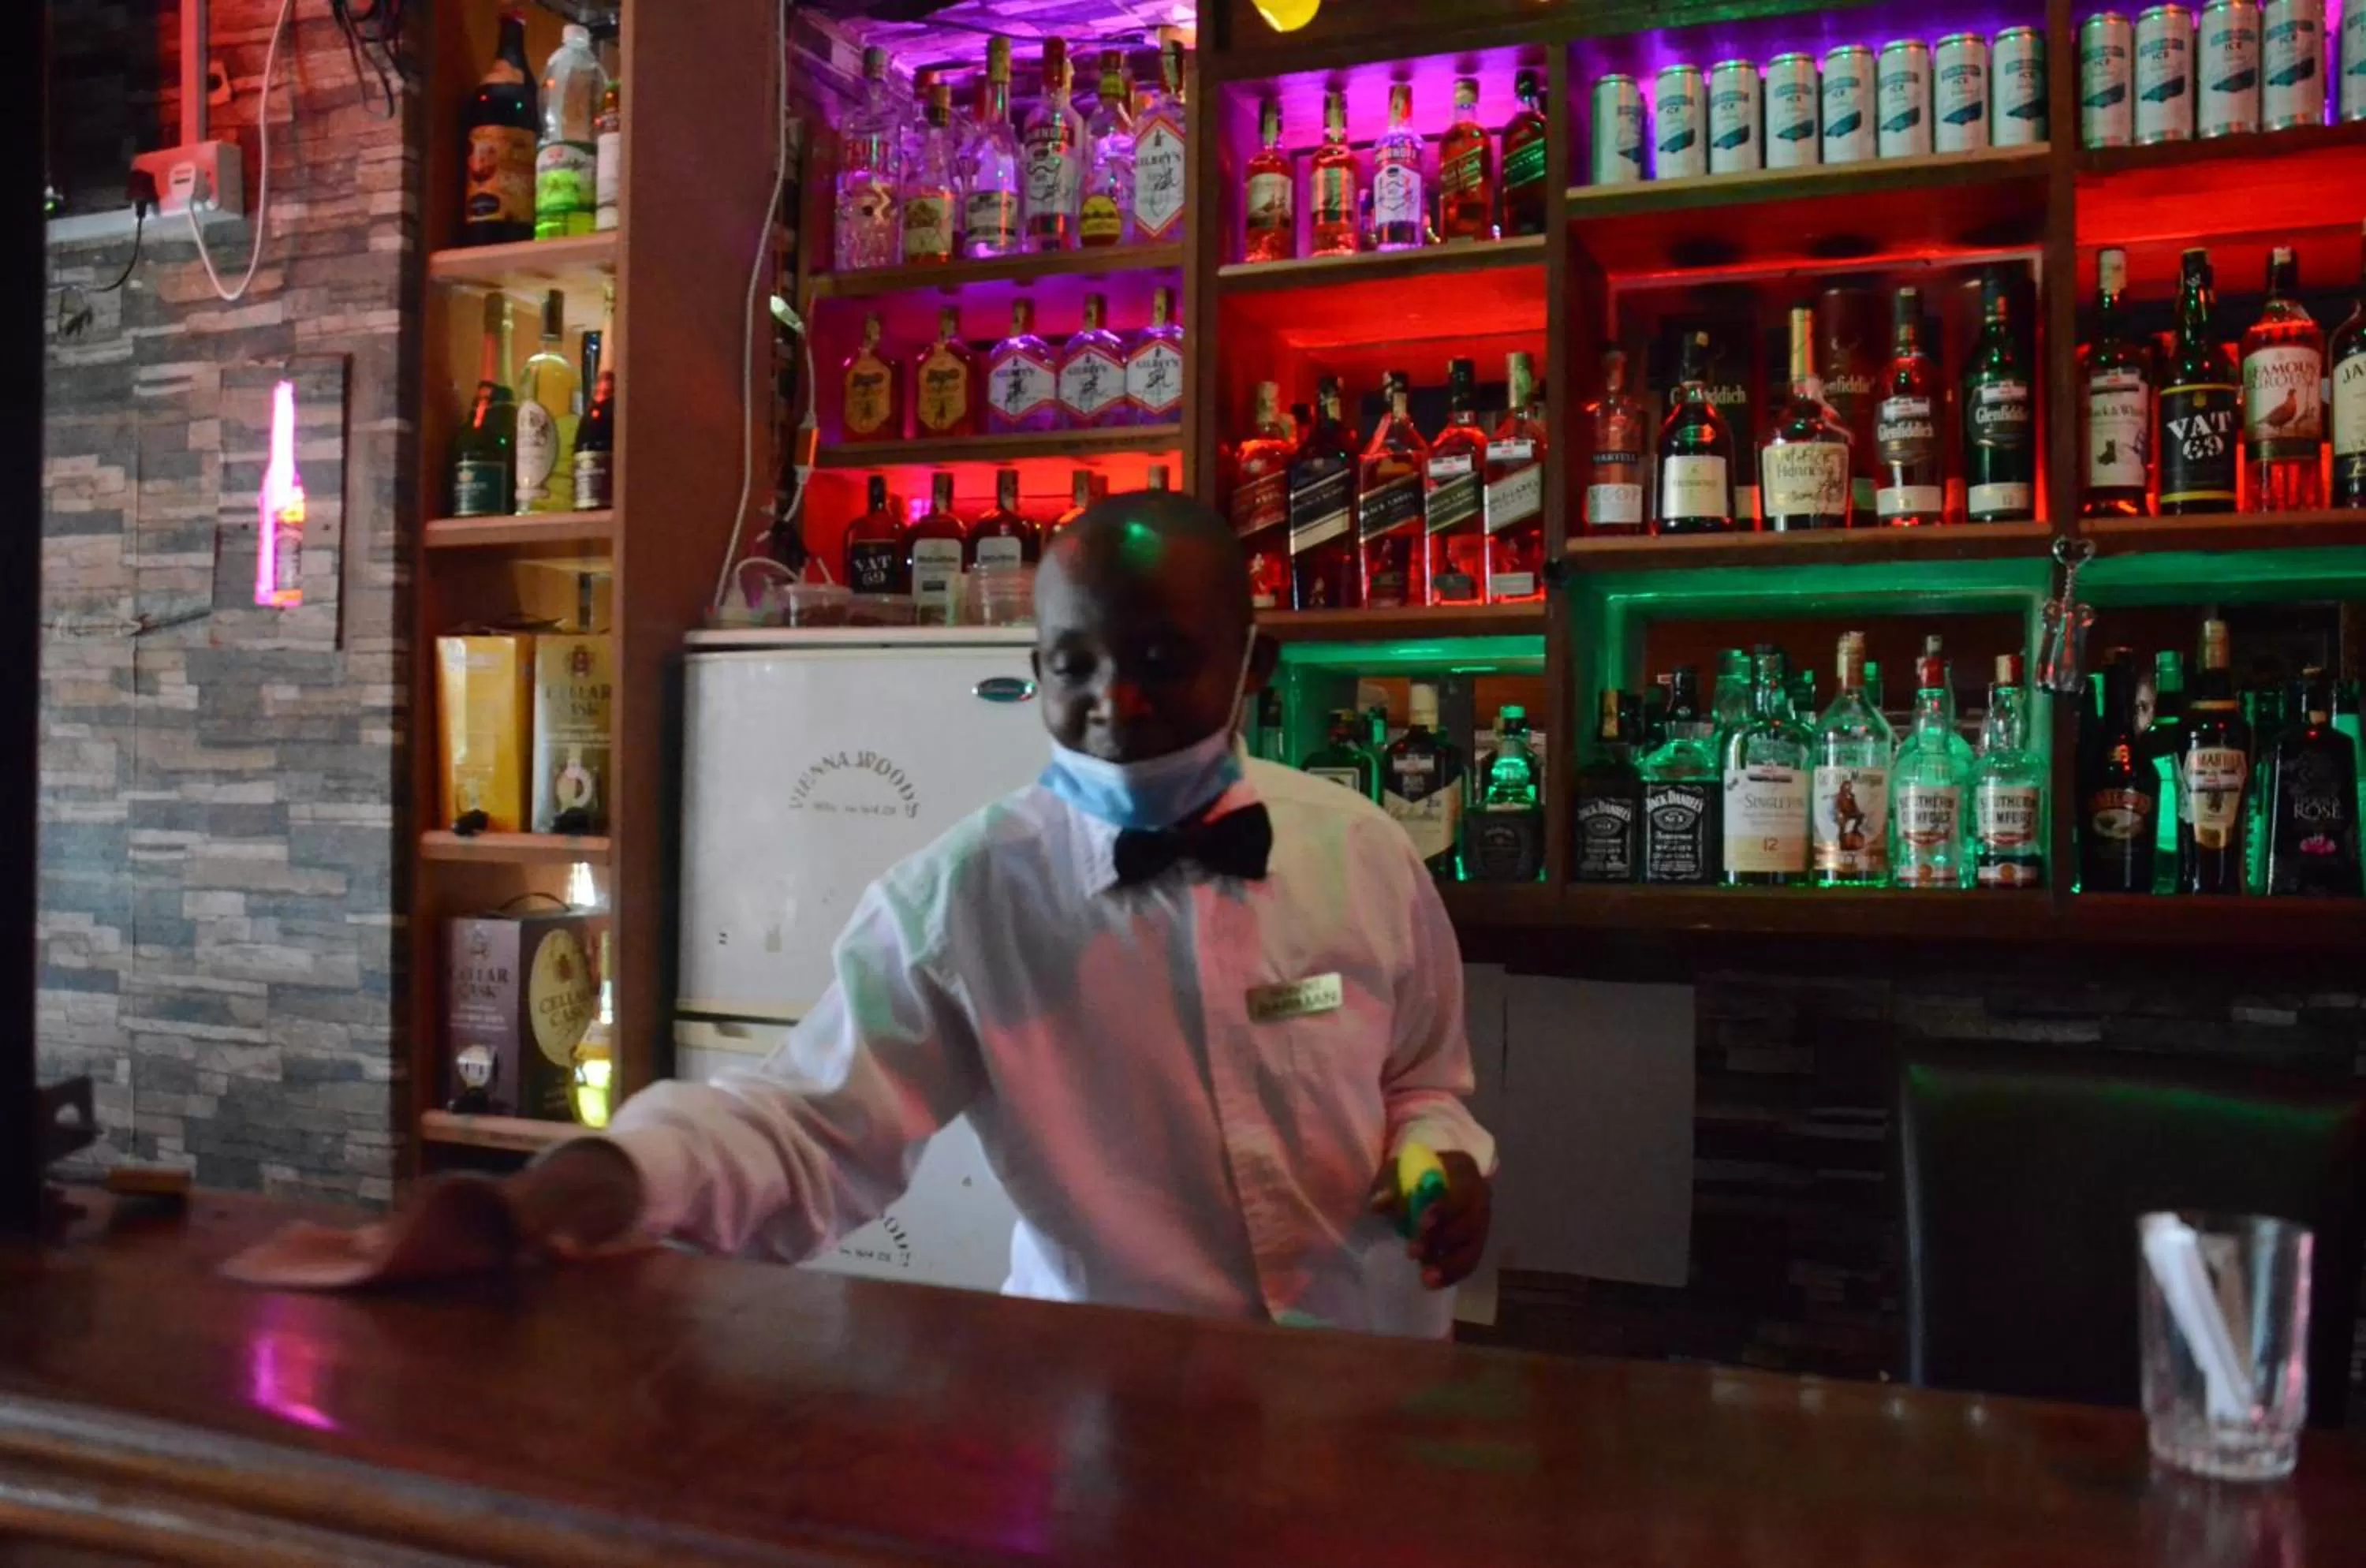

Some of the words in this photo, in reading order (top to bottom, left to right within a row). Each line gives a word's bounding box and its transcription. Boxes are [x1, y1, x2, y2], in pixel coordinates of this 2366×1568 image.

[2253, 361, 2317, 379] FAMOUS
[2342, 358, 2366, 384] JA
[2166, 409, 2232, 441] VAT
[2181, 433, 2225, 461] 69
[852, 554, 893, 572] VAT
[789, 751, 850, 810] VIENNA
[854, 750, 920, 819] WOODS
[1645, 794, 1666, 814] JACK
[1762, 837, 1779, 853] 12
